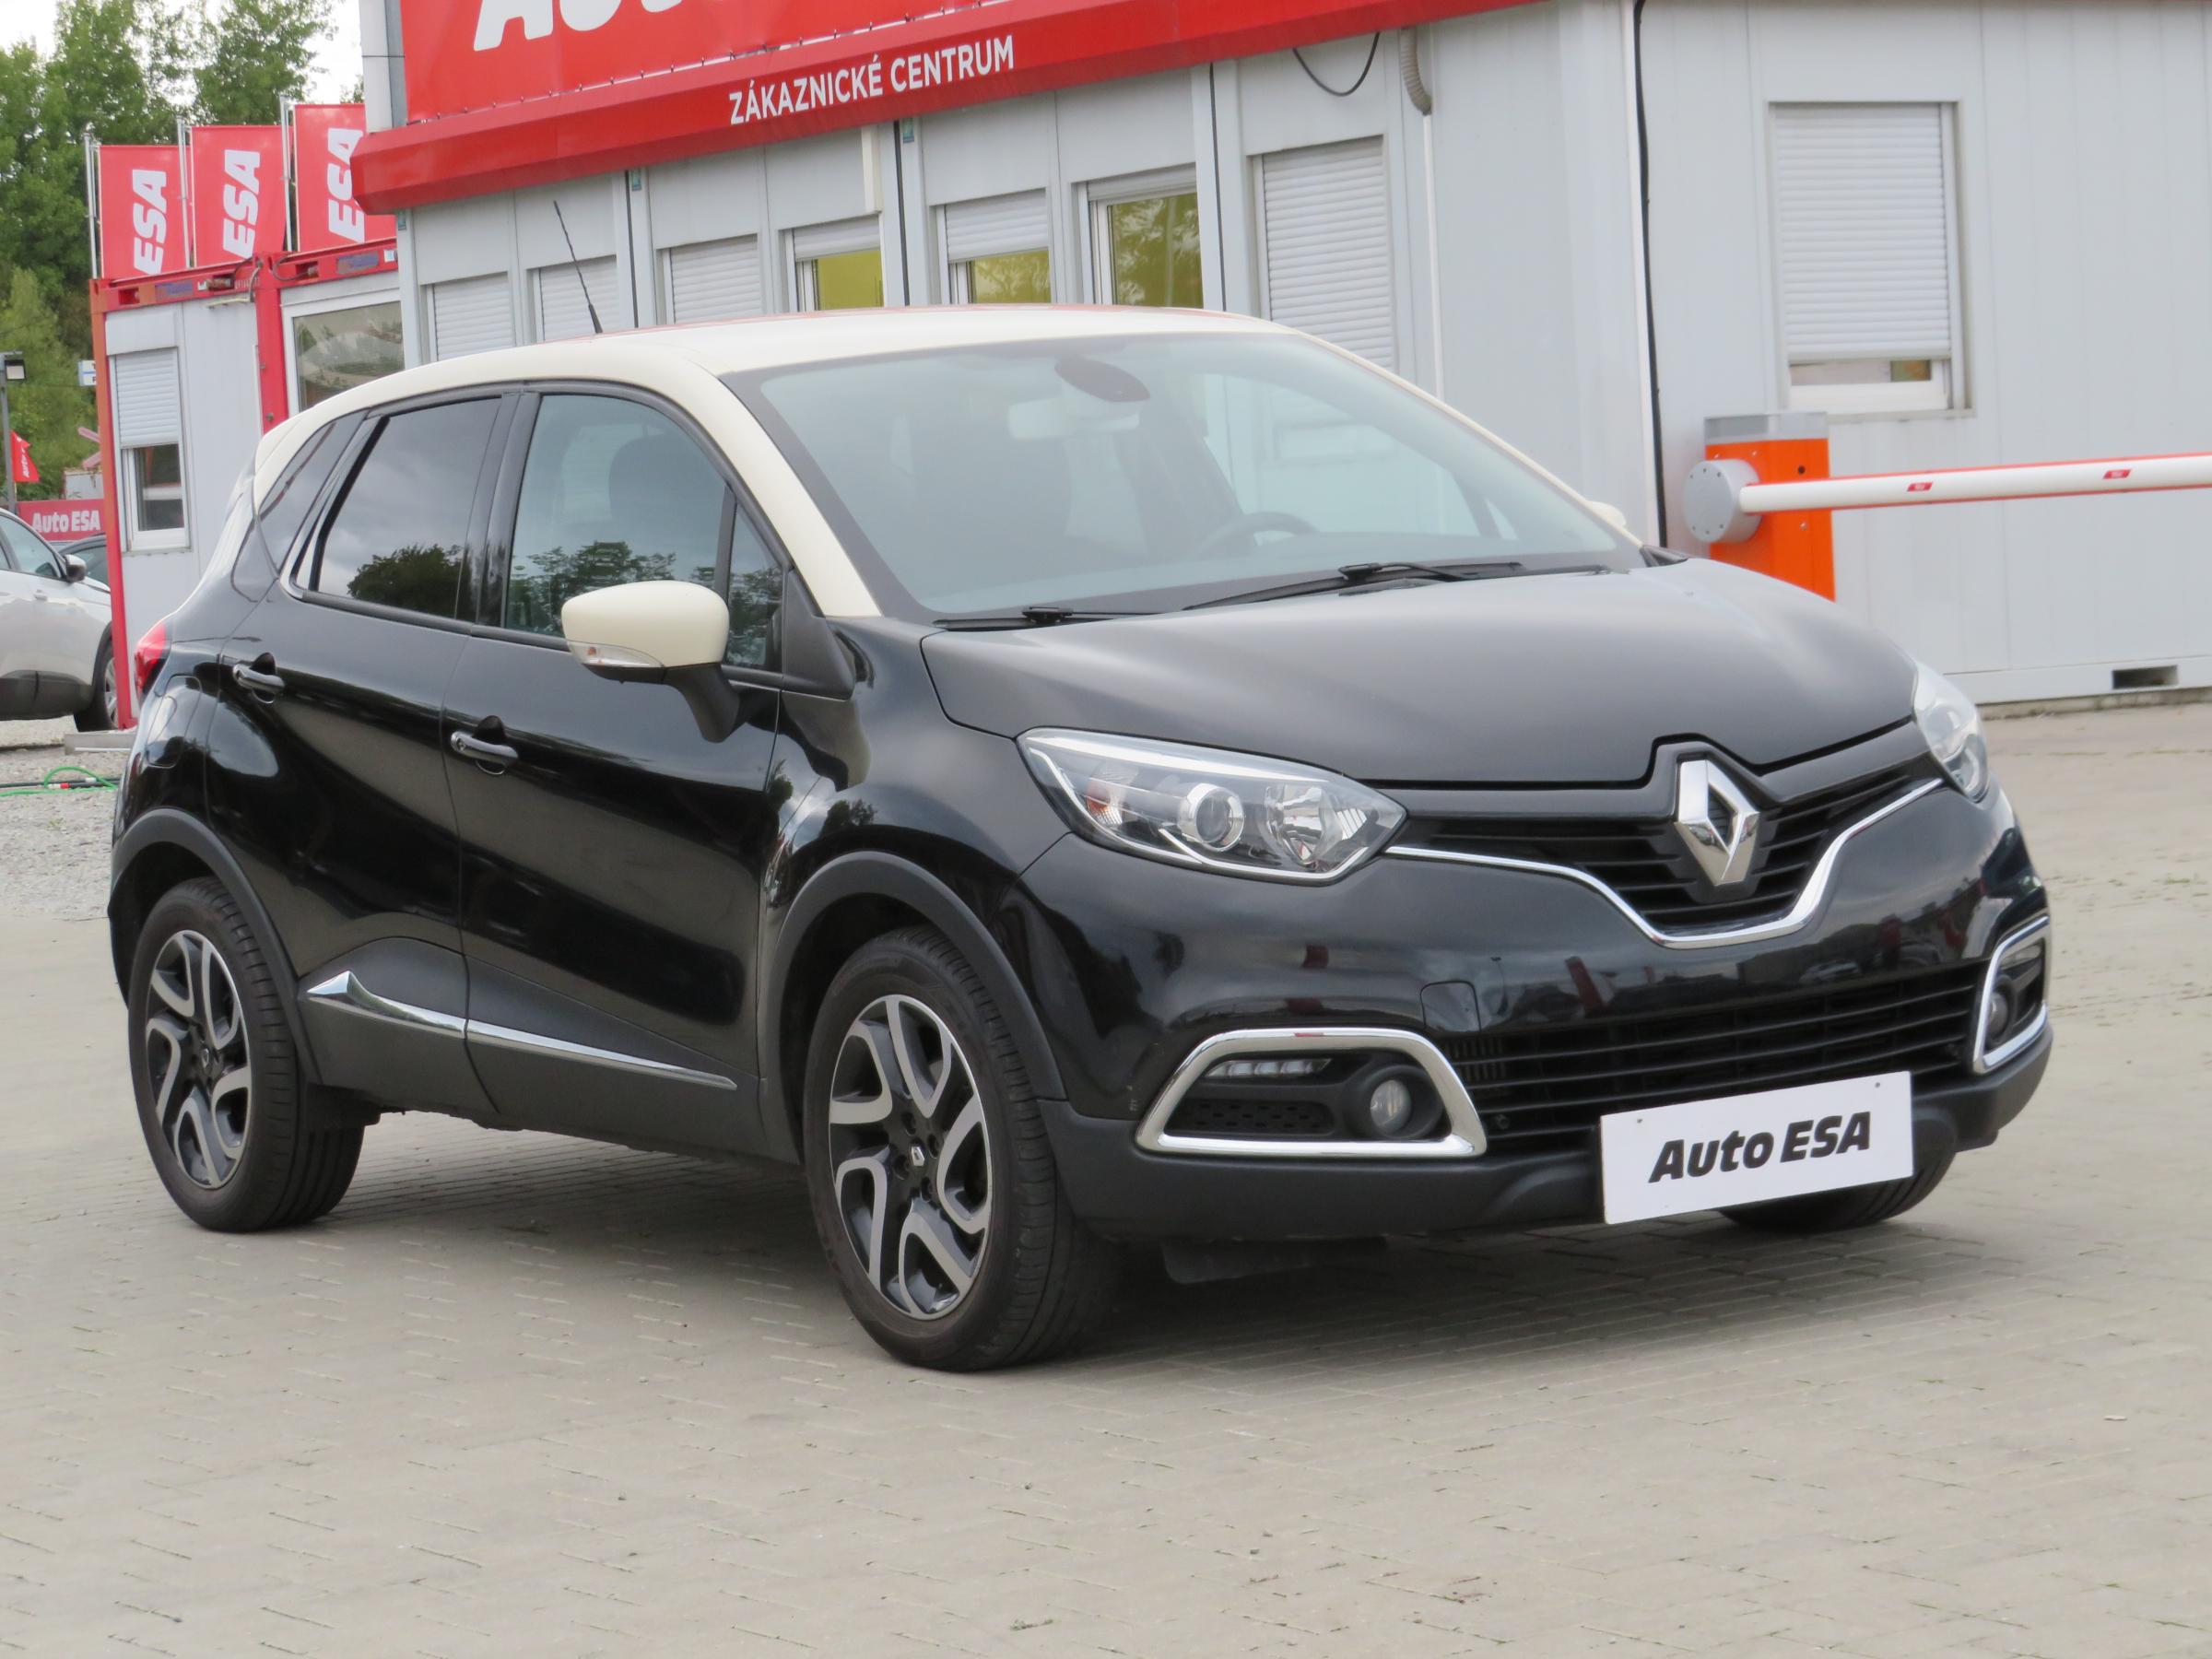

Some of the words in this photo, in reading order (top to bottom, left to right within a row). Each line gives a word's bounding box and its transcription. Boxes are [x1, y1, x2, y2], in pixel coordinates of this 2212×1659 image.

[729, 53, 883, 125] ZÁKAZNICKÉ
[890, 34, 1014, 92] CENTRUM
[132, 169, 167, 275] ESA
[222, 149, 261, 259] ESA
[32, 512, 69, 533] Auto
[71, 510, 101, 531] ESA
[1648, 1130, 1775, 1183] Auto
[1780, 1111, 1871, 1163] ESA
